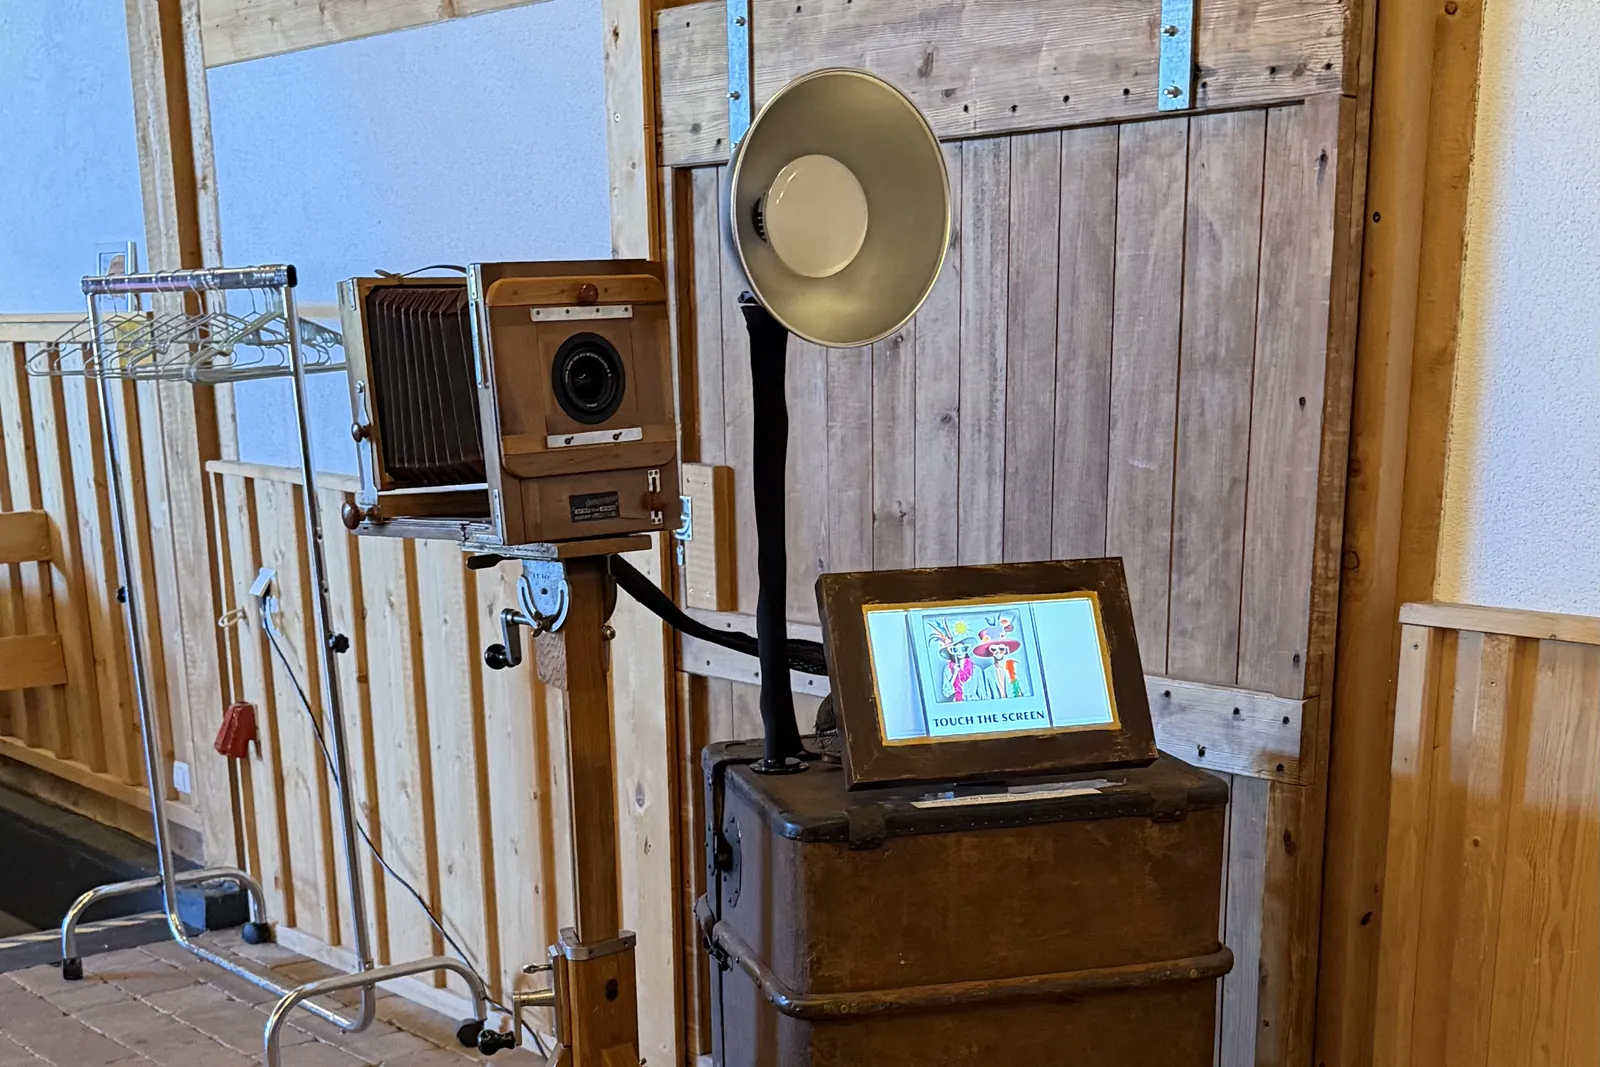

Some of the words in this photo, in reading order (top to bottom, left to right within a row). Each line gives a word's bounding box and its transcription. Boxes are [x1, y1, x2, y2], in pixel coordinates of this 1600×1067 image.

[933, 715, 974, 728] TOUCH
[976, 713, 999, 724] THE
[1002, 710, 1045, 722] SCREEN
